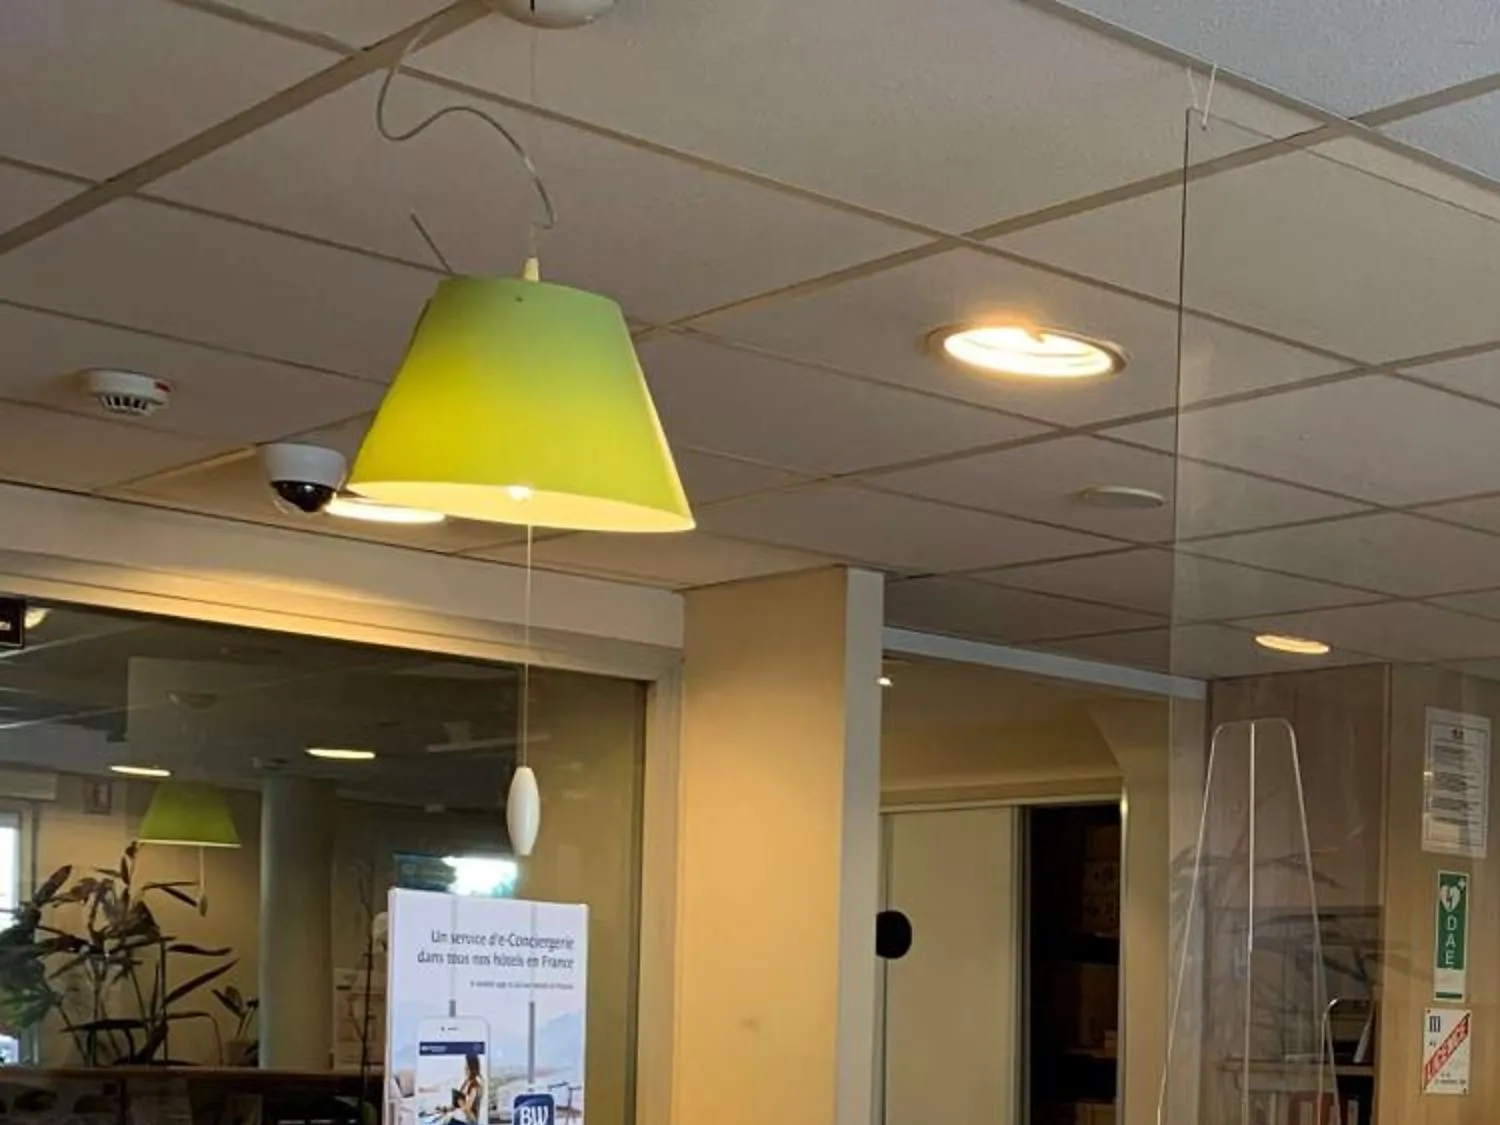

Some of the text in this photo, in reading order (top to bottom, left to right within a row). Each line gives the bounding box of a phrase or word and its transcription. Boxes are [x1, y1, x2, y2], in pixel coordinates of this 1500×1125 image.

[431, 929, 449, 943] Un
[451, 933, 487, 947] service
[1446, 915, 1458, 965] DAE
[417, 949, 444, 963] dans
[472, 954, 491, 966] nos
[527, 957, 540, 968] en
[541, 955, 575, 969] France
